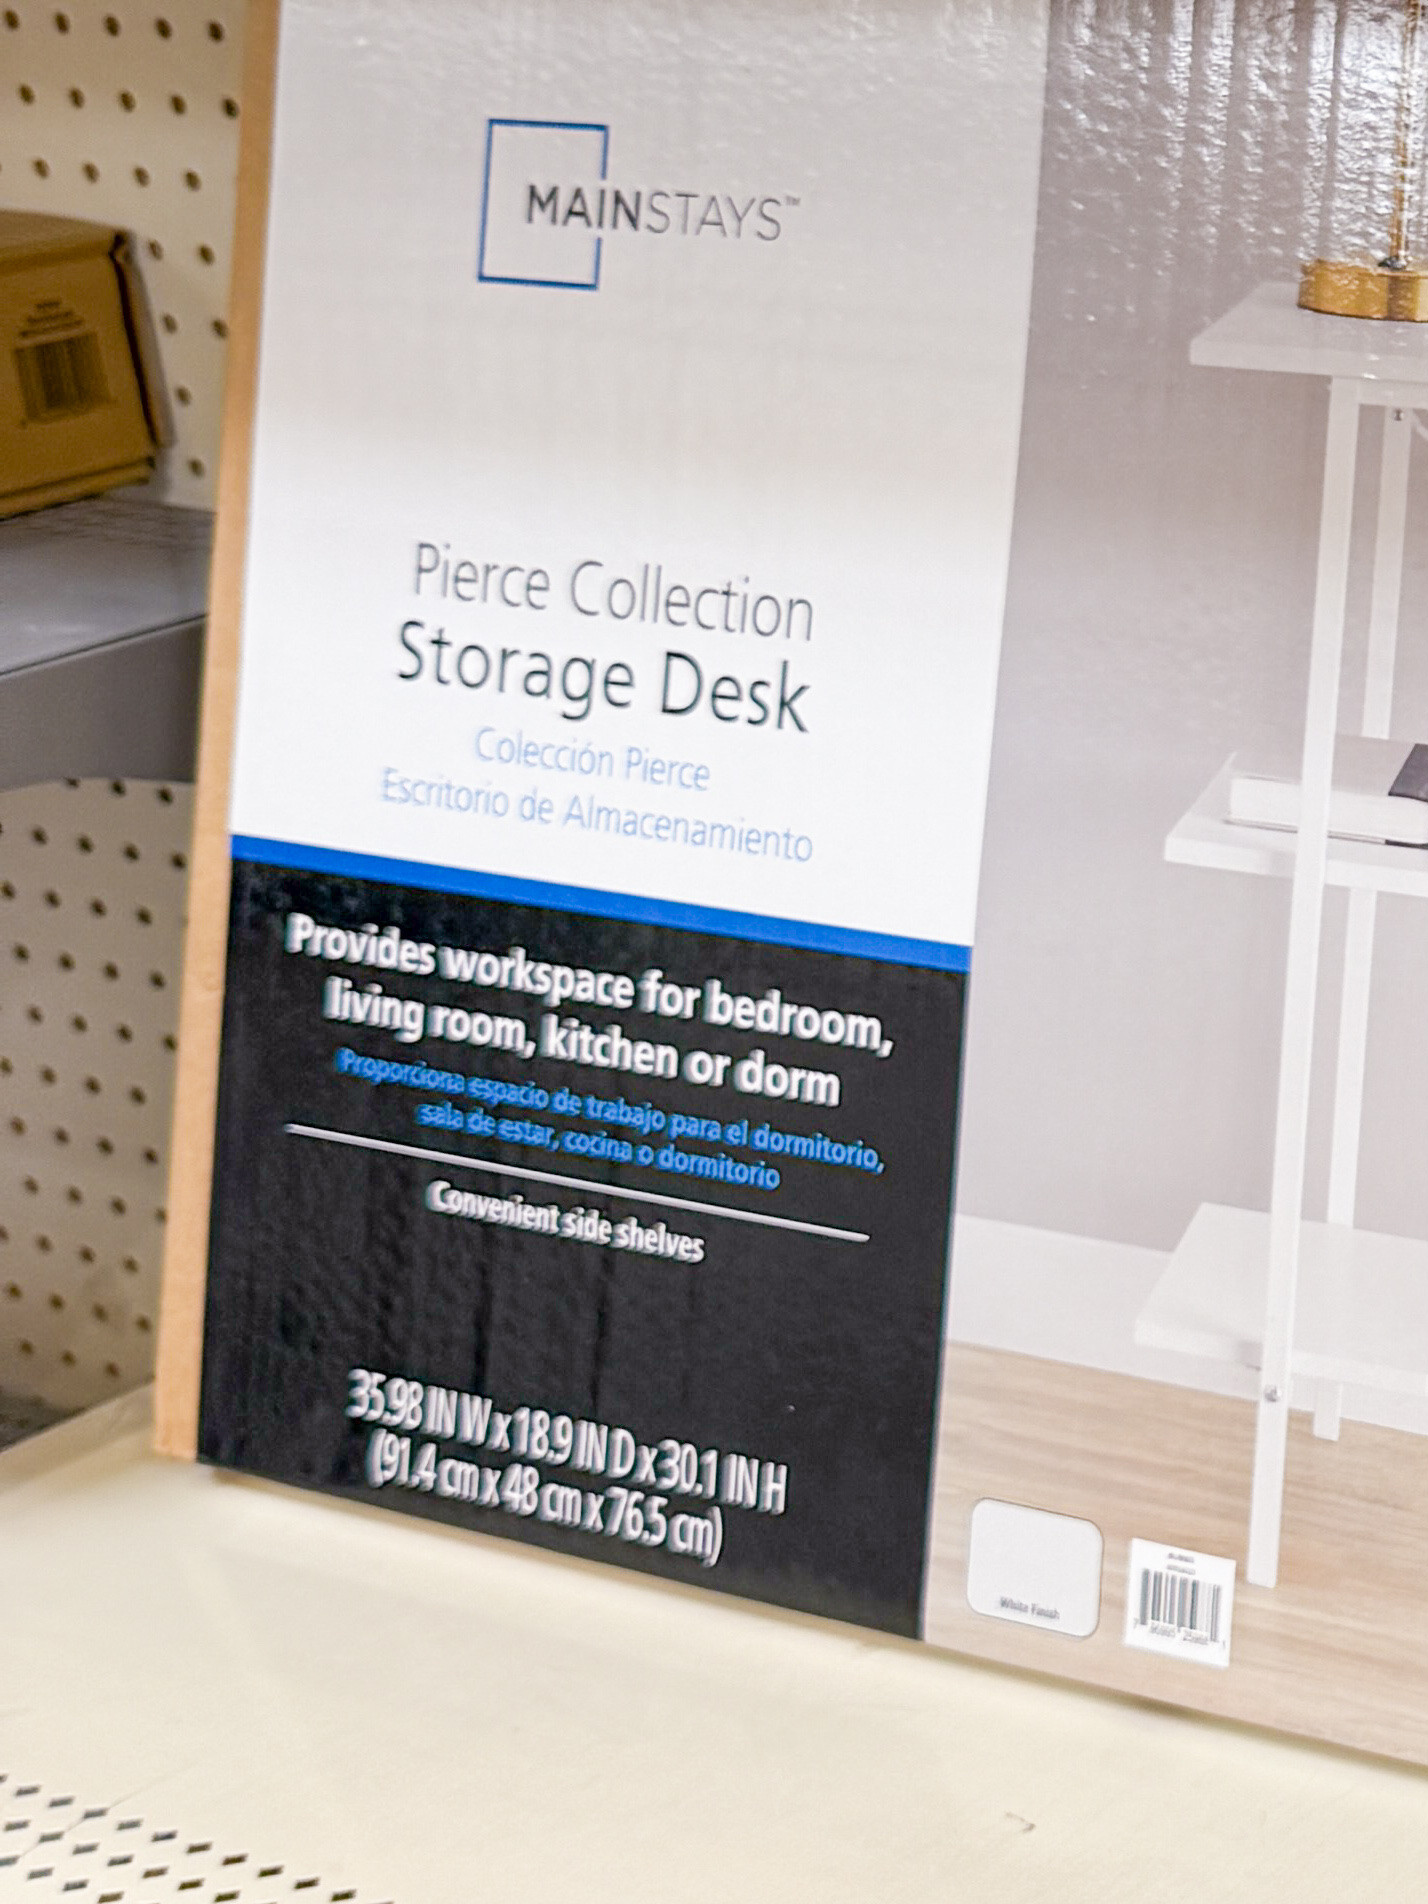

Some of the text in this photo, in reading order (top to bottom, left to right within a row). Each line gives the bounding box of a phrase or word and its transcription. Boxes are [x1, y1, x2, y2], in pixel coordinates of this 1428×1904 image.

[414, 541, 813, 642] Pierce Collection
[398, 619, 810, 733] Storage Desk
[474, 726, 711, 792] Colección Pierce
[380, 766, 813, 863] Escritorio de Almacenamiento
[286, 912, 893, 1058] Provides workspace for bedroom,
[324, 975, 840, 1107] living room, kitchen or dorm
[426, 1180, 705, 1263] Convenient side shelves
[656, 1439, 718, 1499] 30.1
